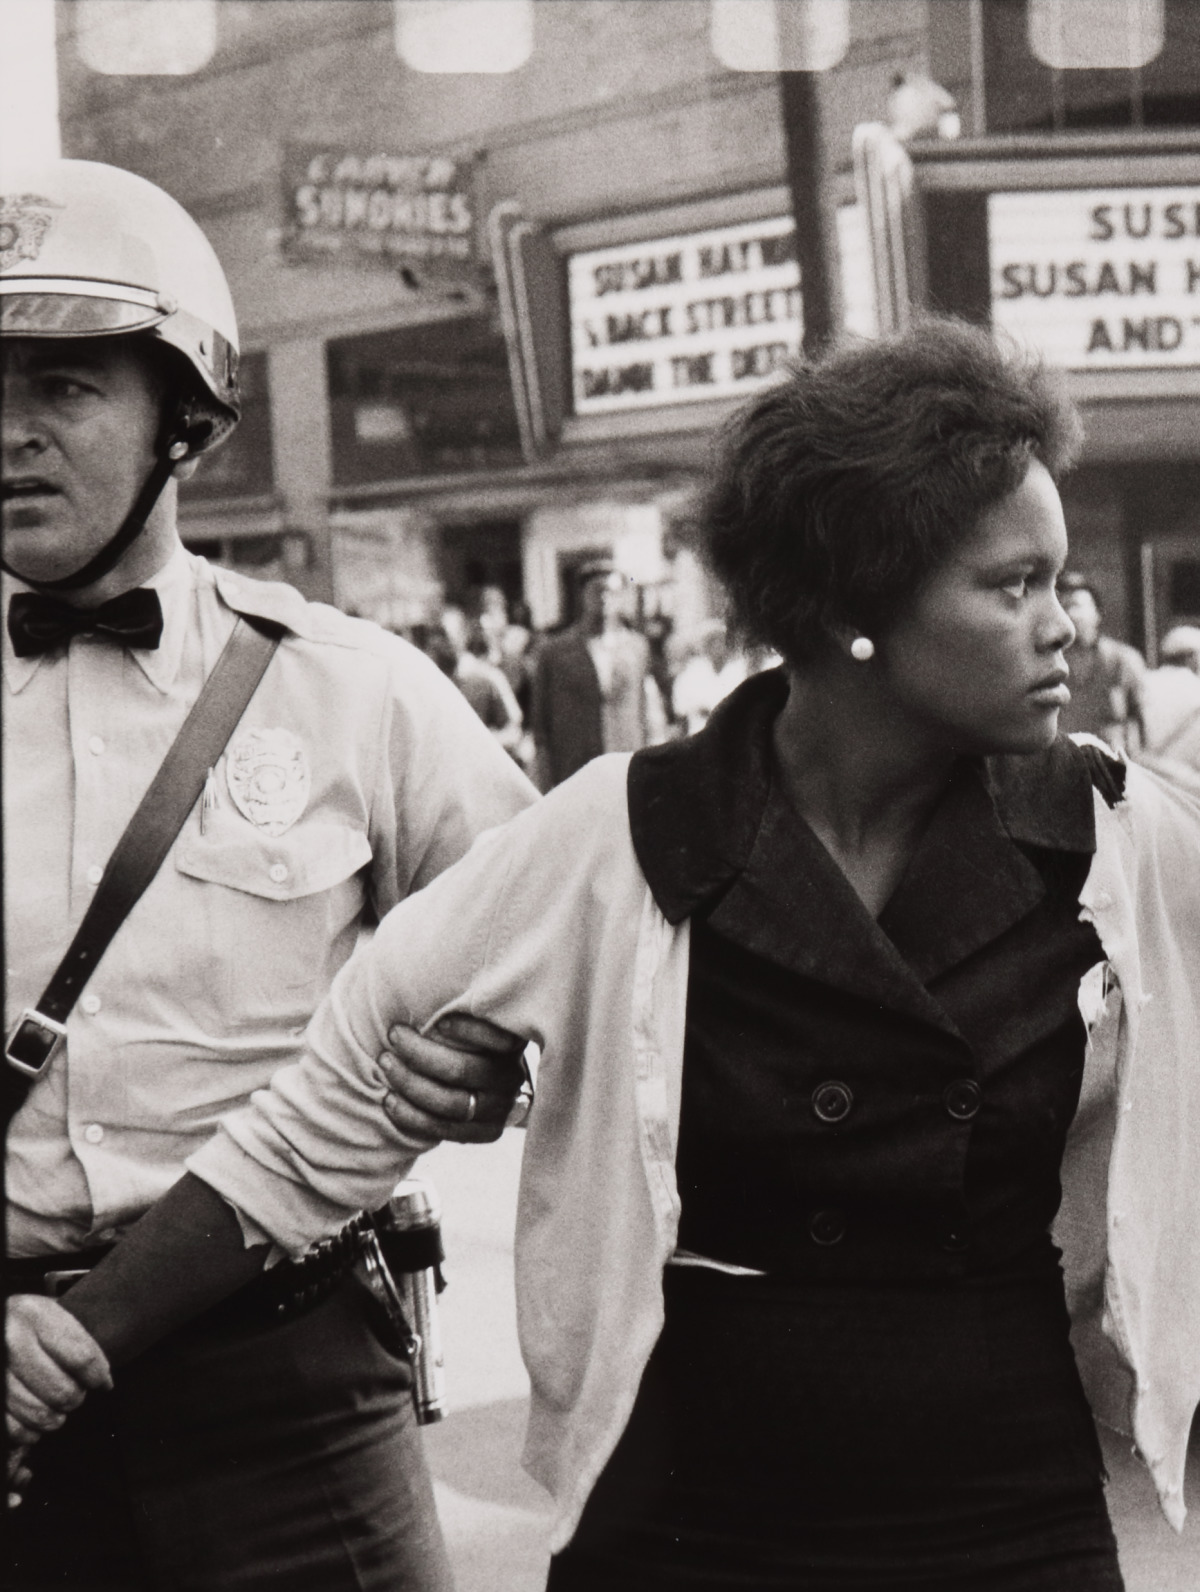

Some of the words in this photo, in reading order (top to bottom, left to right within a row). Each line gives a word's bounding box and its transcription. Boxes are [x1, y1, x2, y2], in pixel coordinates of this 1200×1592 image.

[594, 253, 683, 298] SUSAN
[1001, 262, 1157, 300] SUSAN
[606, 306, 672, 344] BACK
[1087, 315, 1184, 354] AND
[670, 351, 715, 387] THE
